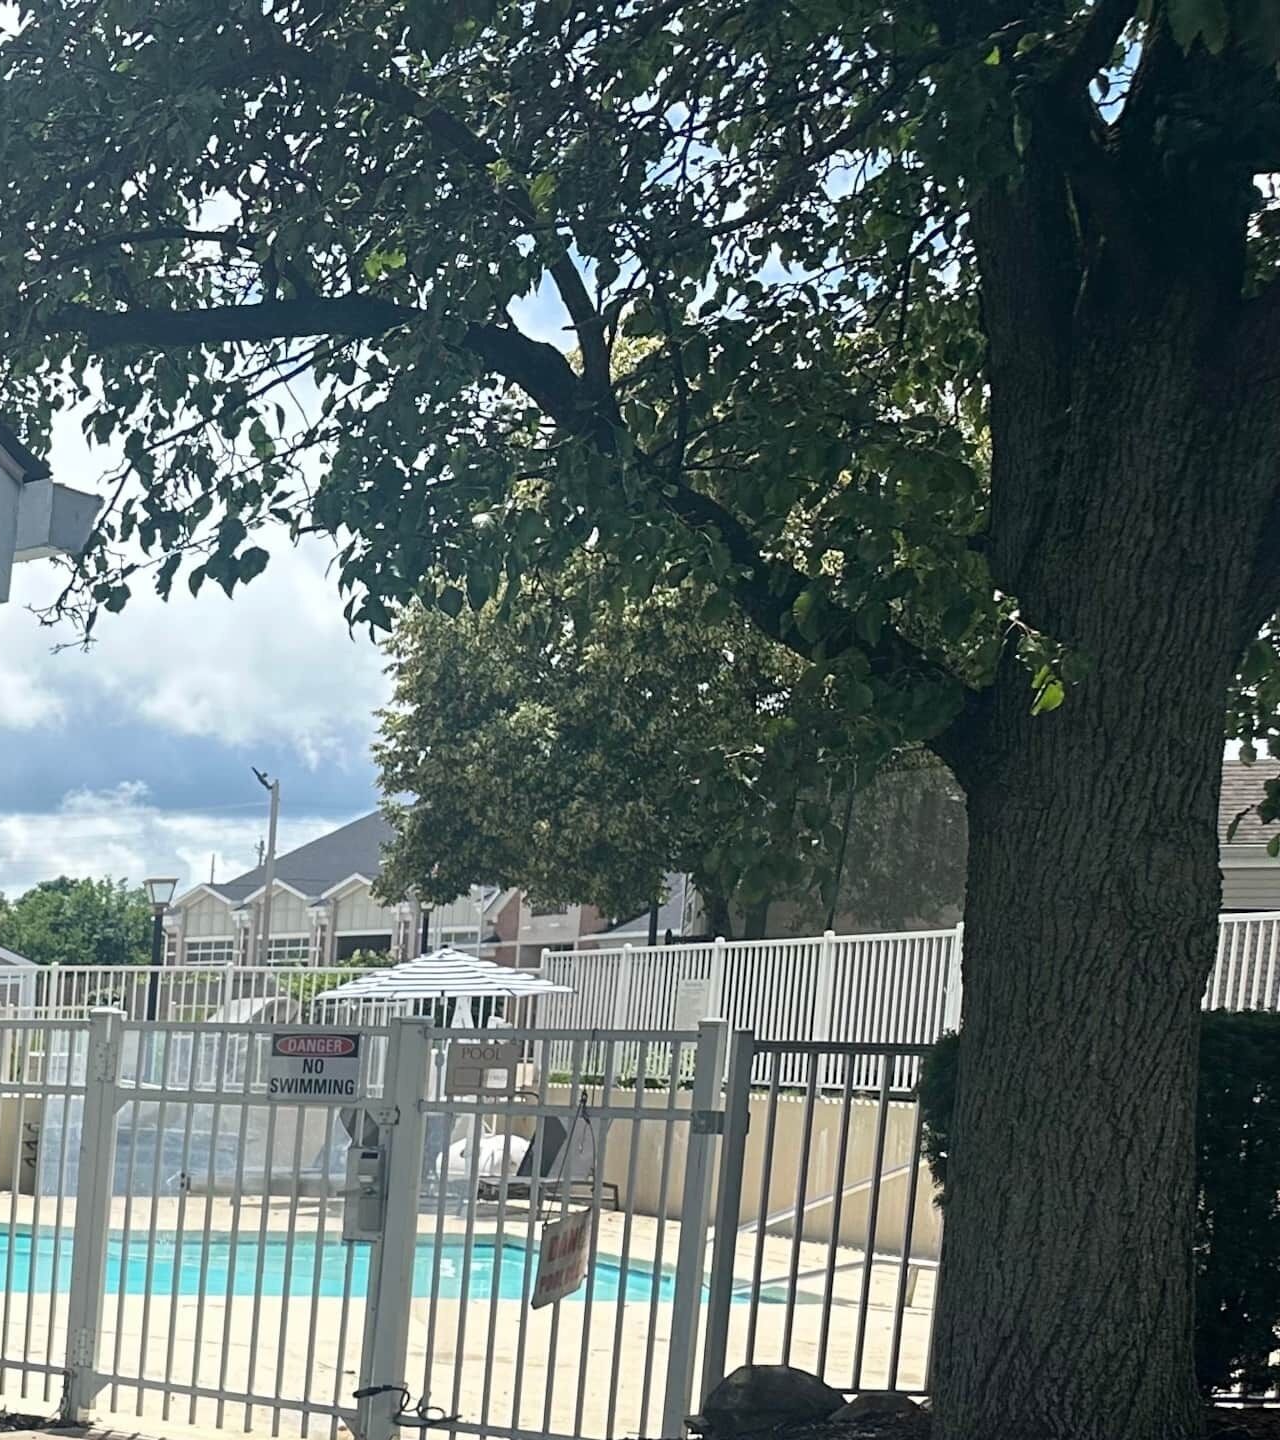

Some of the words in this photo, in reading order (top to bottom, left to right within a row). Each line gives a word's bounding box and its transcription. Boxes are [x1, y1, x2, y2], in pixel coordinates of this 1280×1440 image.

[287, 1038, 343, 1053] DANGER
[462, 1047, 503, 1060] POOL
[302, 1058, 325, 1075] NO
[270, 1078, 355, 1096] SWIMMING
